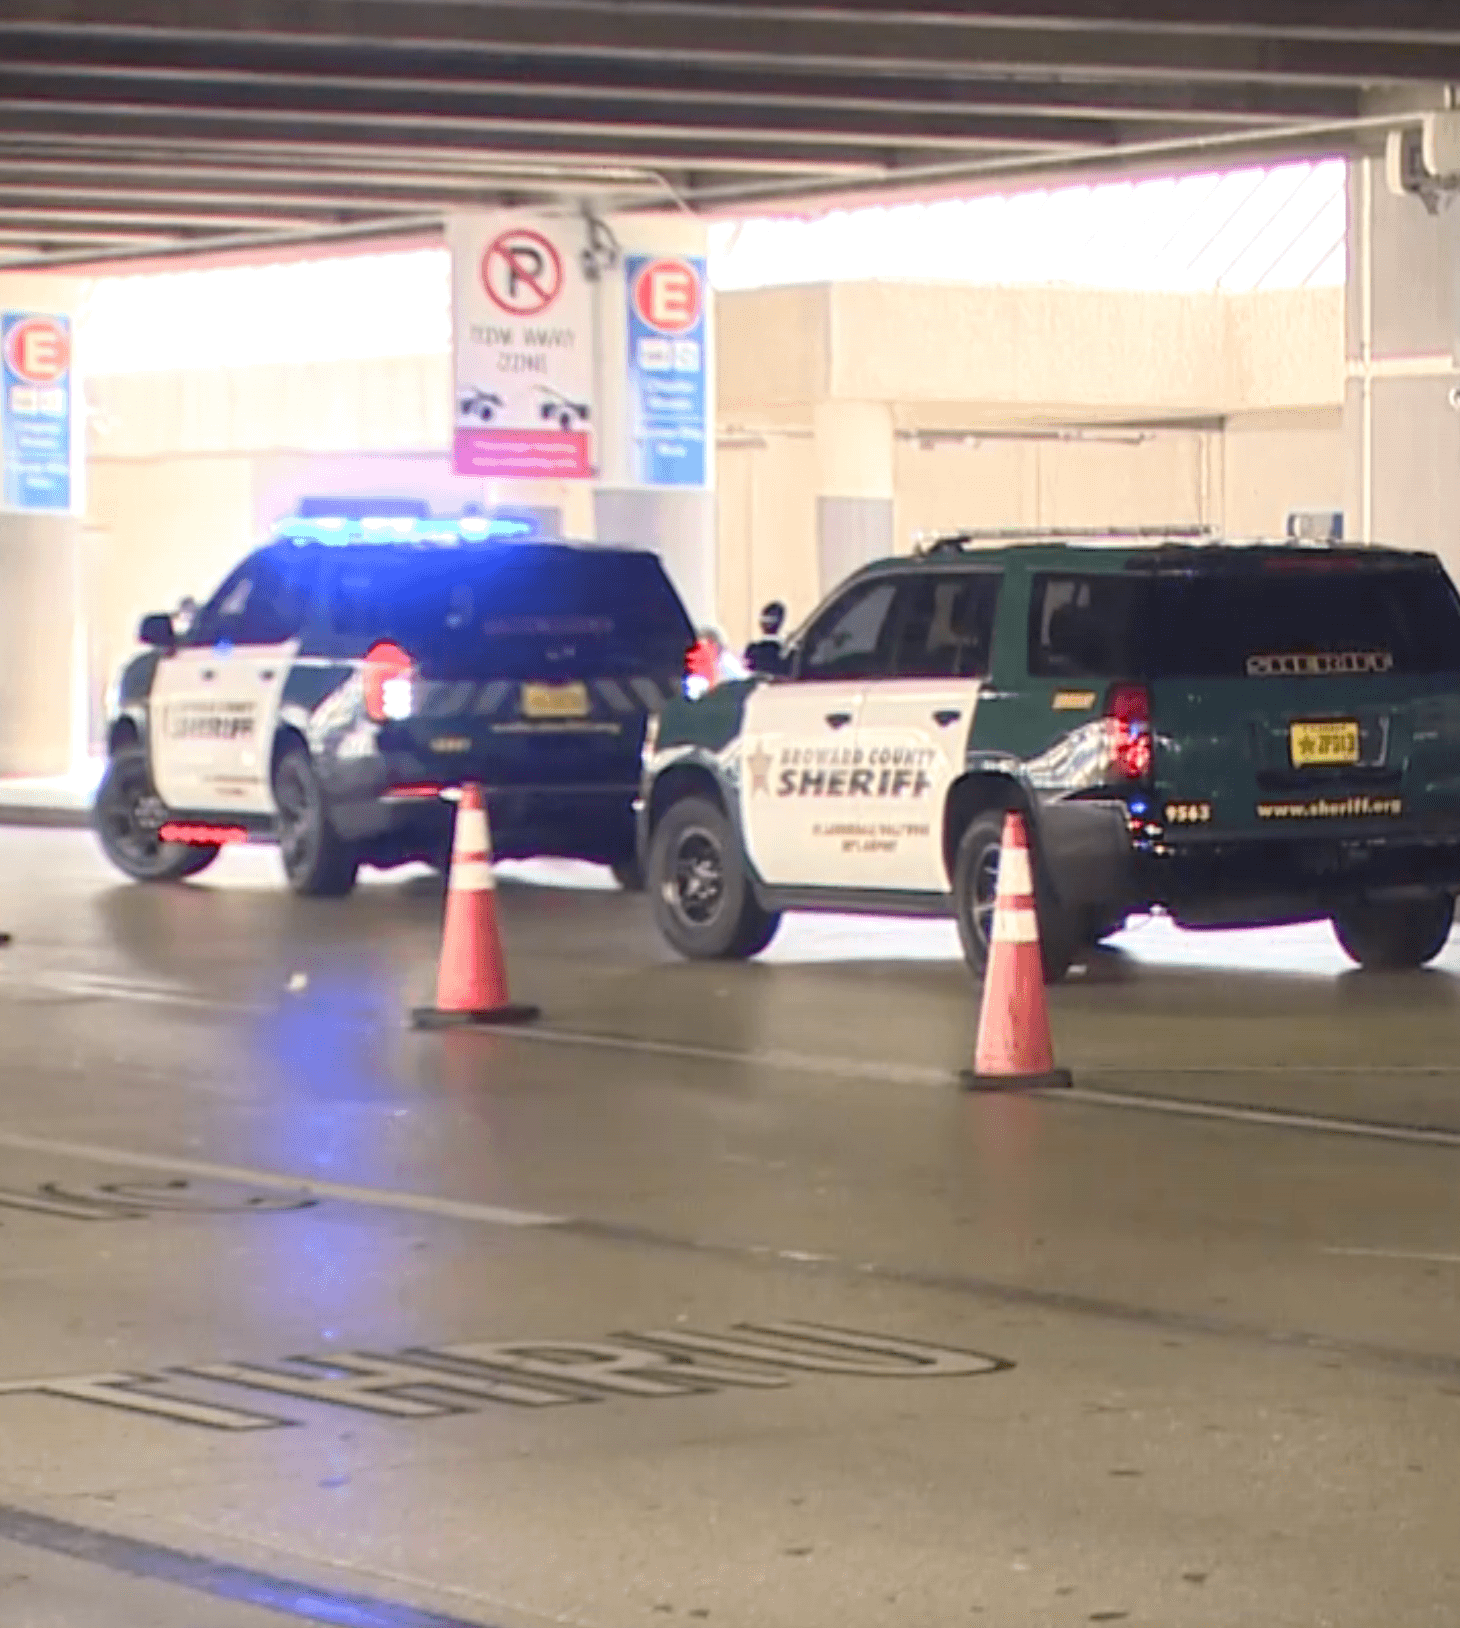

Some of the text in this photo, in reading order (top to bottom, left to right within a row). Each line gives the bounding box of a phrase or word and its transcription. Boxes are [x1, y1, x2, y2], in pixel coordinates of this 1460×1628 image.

[654, 274, 688, 319] E
[25, 331, 57, 371] E
[777, 768, 932, 797] SHERIFF
[0, 1320, 1016, 1432] THRU
